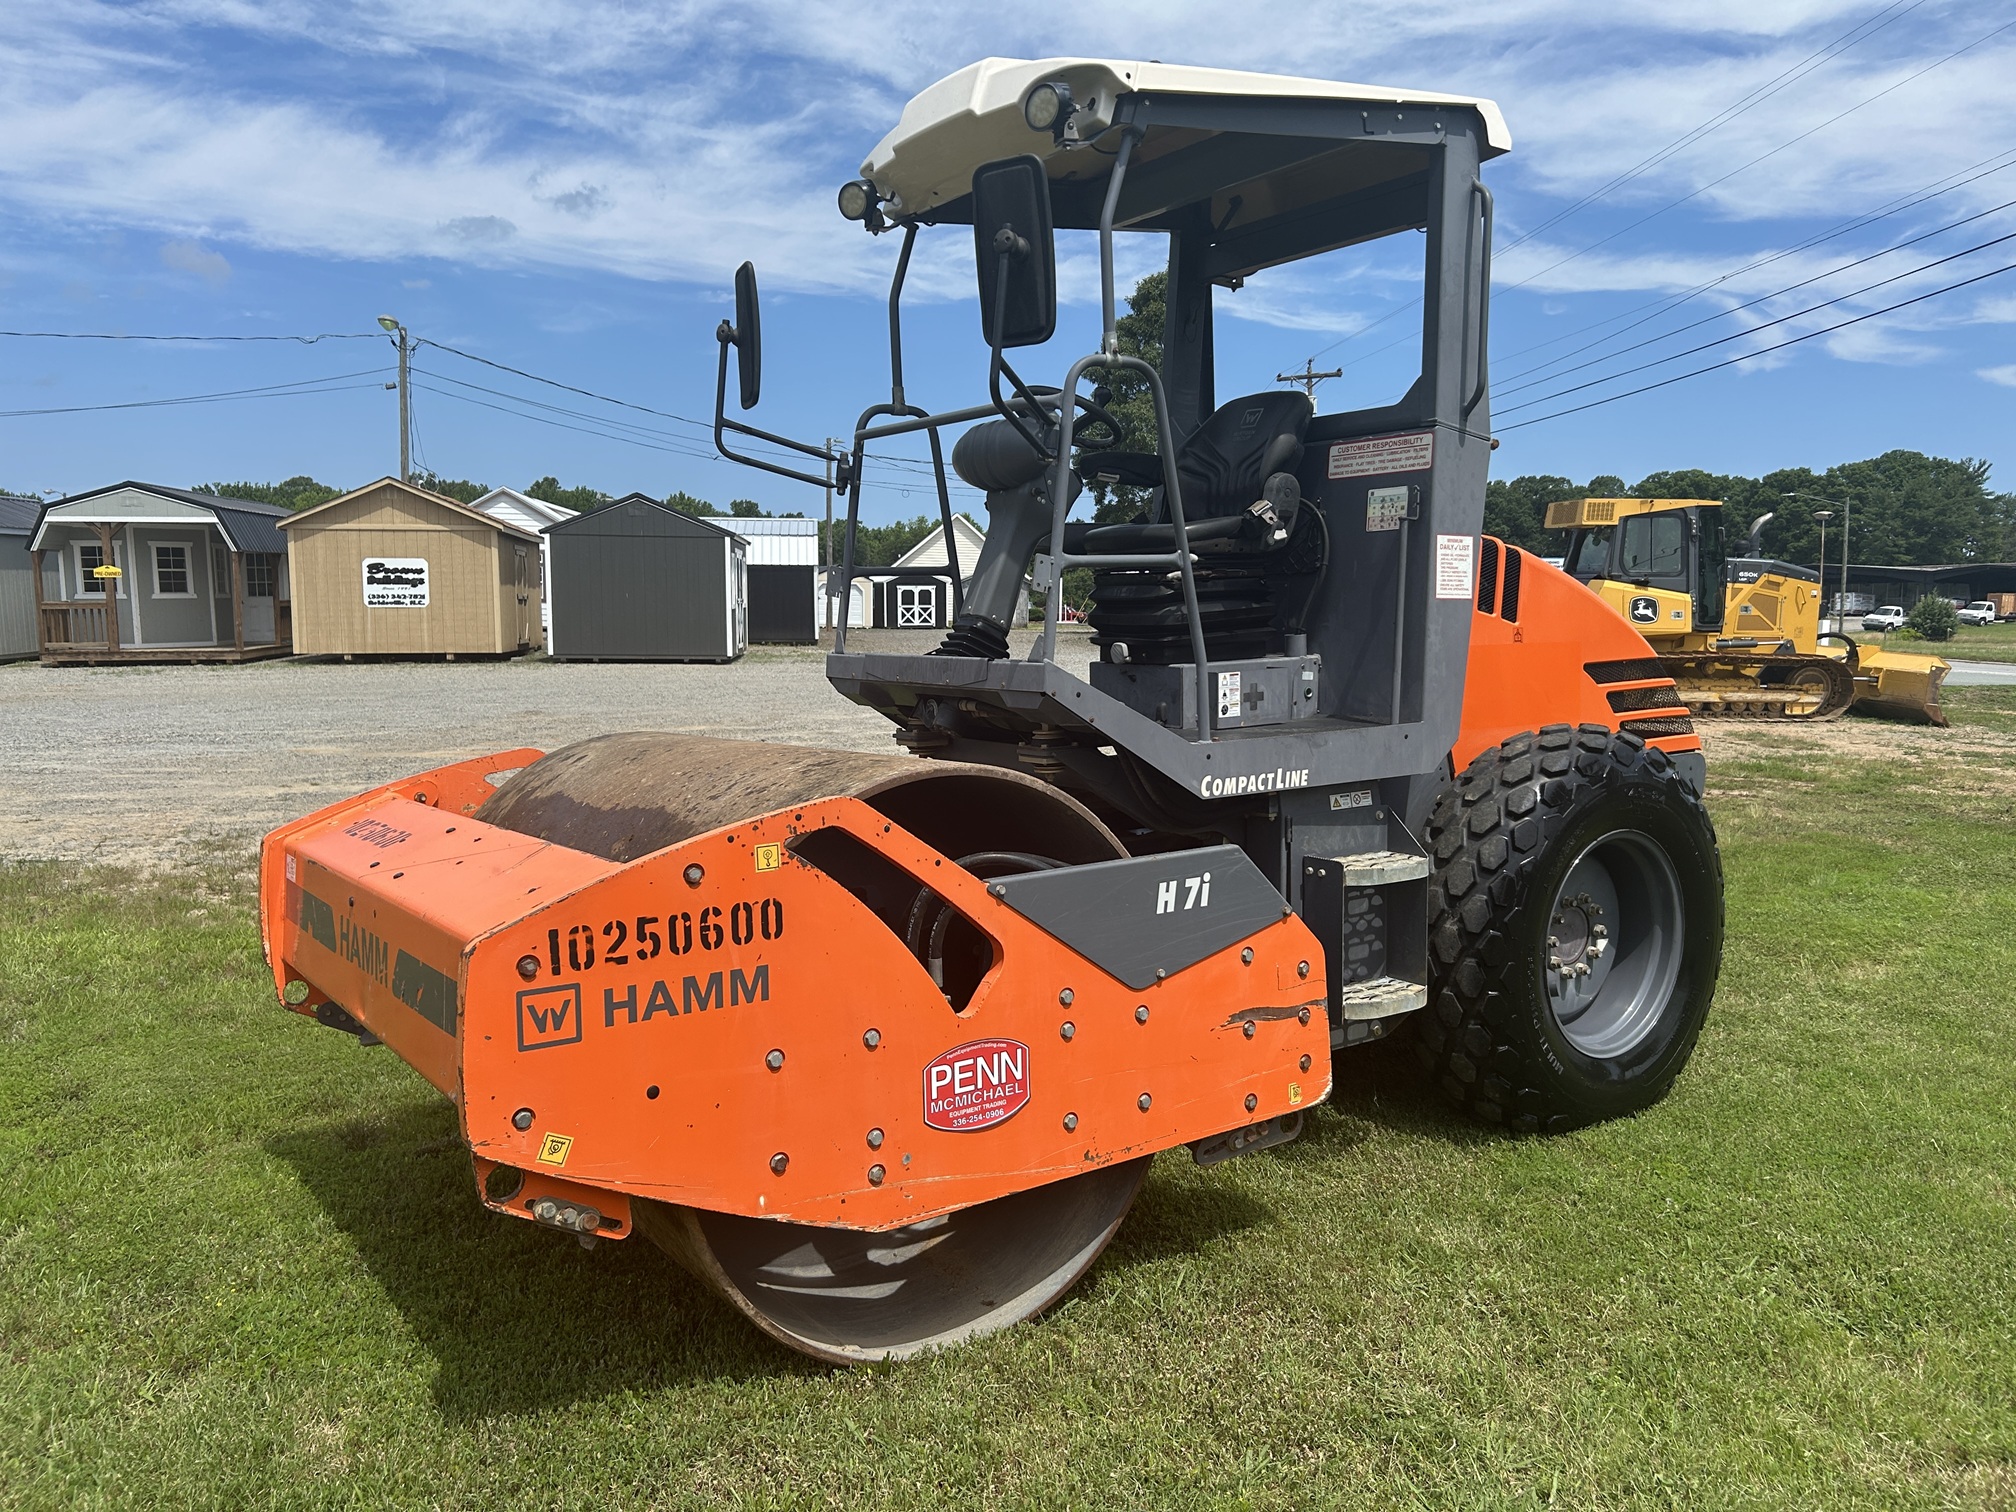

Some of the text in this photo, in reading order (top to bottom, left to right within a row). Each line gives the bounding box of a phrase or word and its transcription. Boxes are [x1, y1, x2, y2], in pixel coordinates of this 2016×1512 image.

[1338, 437, 1424, 454] CUSTOMER RESPONSIBILITY
[1156, 872, 1212, 915] H 7i
[339, 914, 389, 989] HAMM
[548, 897, 784, 976] 10250600
[603, 964, 769, 1028] HAMM
[946, 1042, 1008, 1060] PennEquipmentTrading.com
[931, 1048, 1022, 1100] PENN
[930, 1082, 1024, 1114] MCMICHAEL
[949, 1098, 1007, 1119] EQUIPMENT TRADING
[952, 1108, 1005, 1127] 336-254-0906
